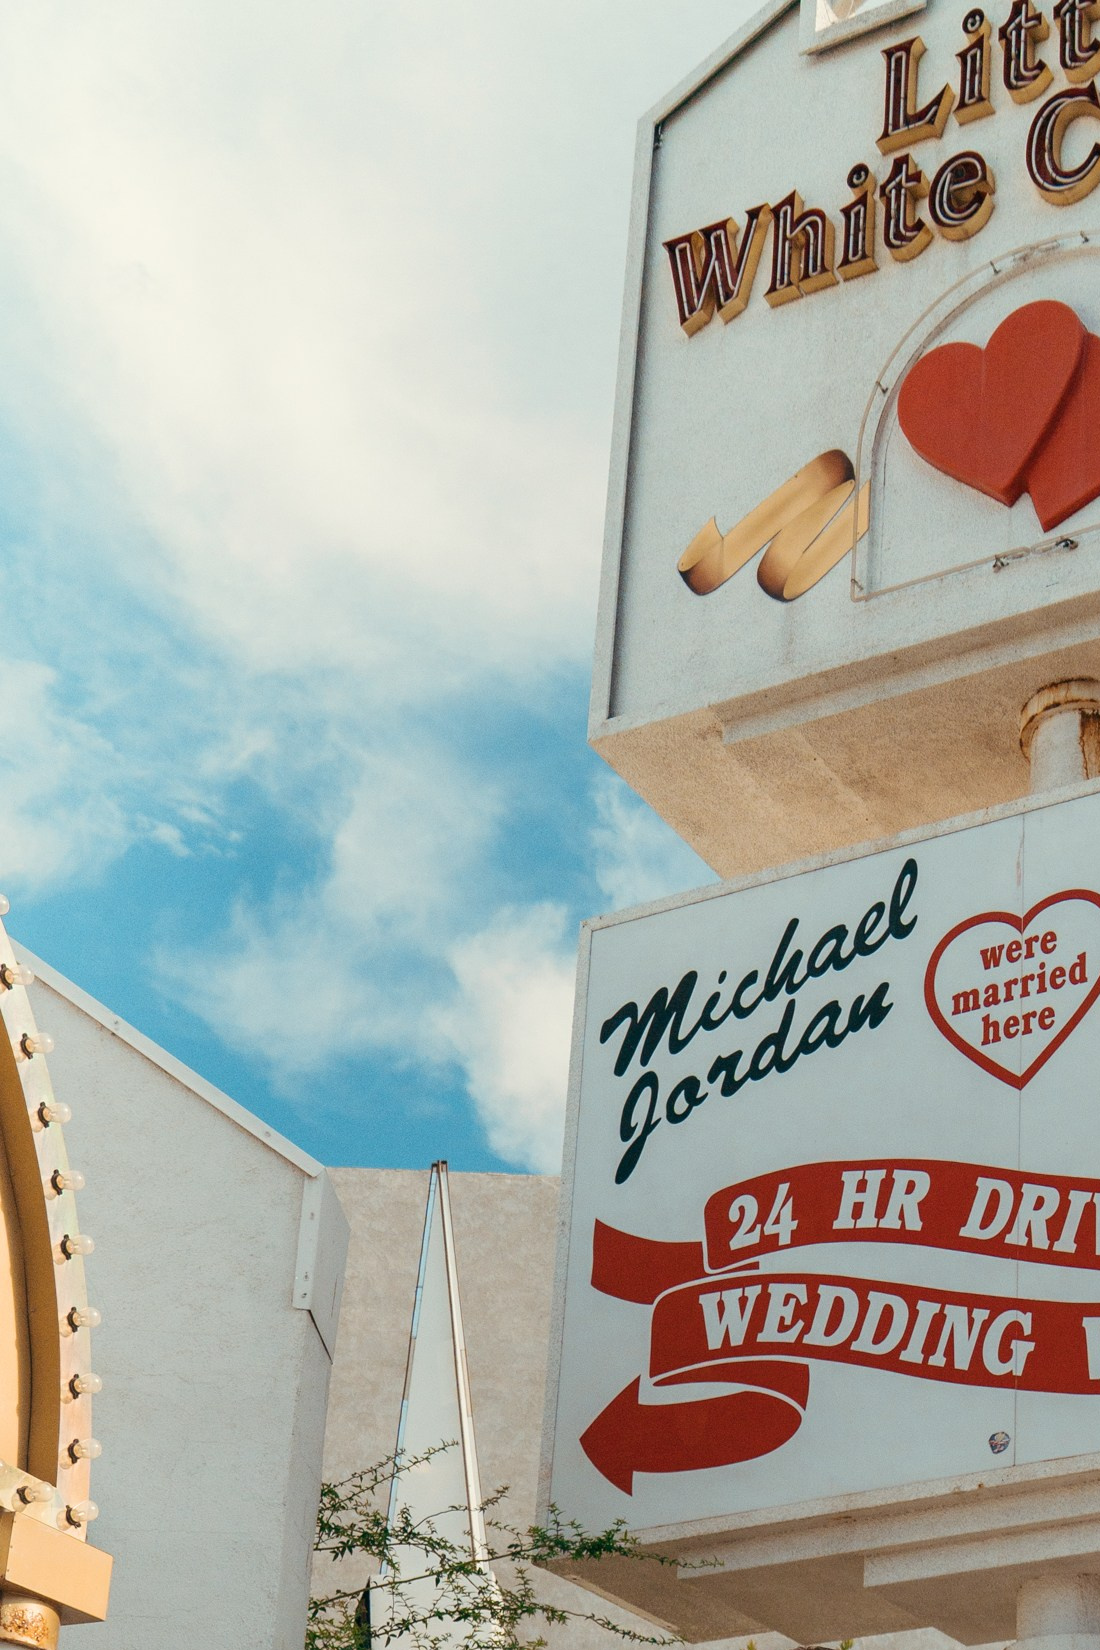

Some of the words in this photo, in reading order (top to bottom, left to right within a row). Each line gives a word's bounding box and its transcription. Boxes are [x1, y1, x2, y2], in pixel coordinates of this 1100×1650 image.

[663, 150, 996, 337] White
[600, 858, 918, 1077] Michael
[952, 952, 1088, 1016] married
[980, 930, 1057, 970] were
[981, 1006, 1055, 1046] here
[614, 982, 893, 1185] Jordan
[728, 1183, 798, 1251] 24
[832, 1169, 932, 1231] HR
[699, 1283, 1036, 1378] WEDDING
